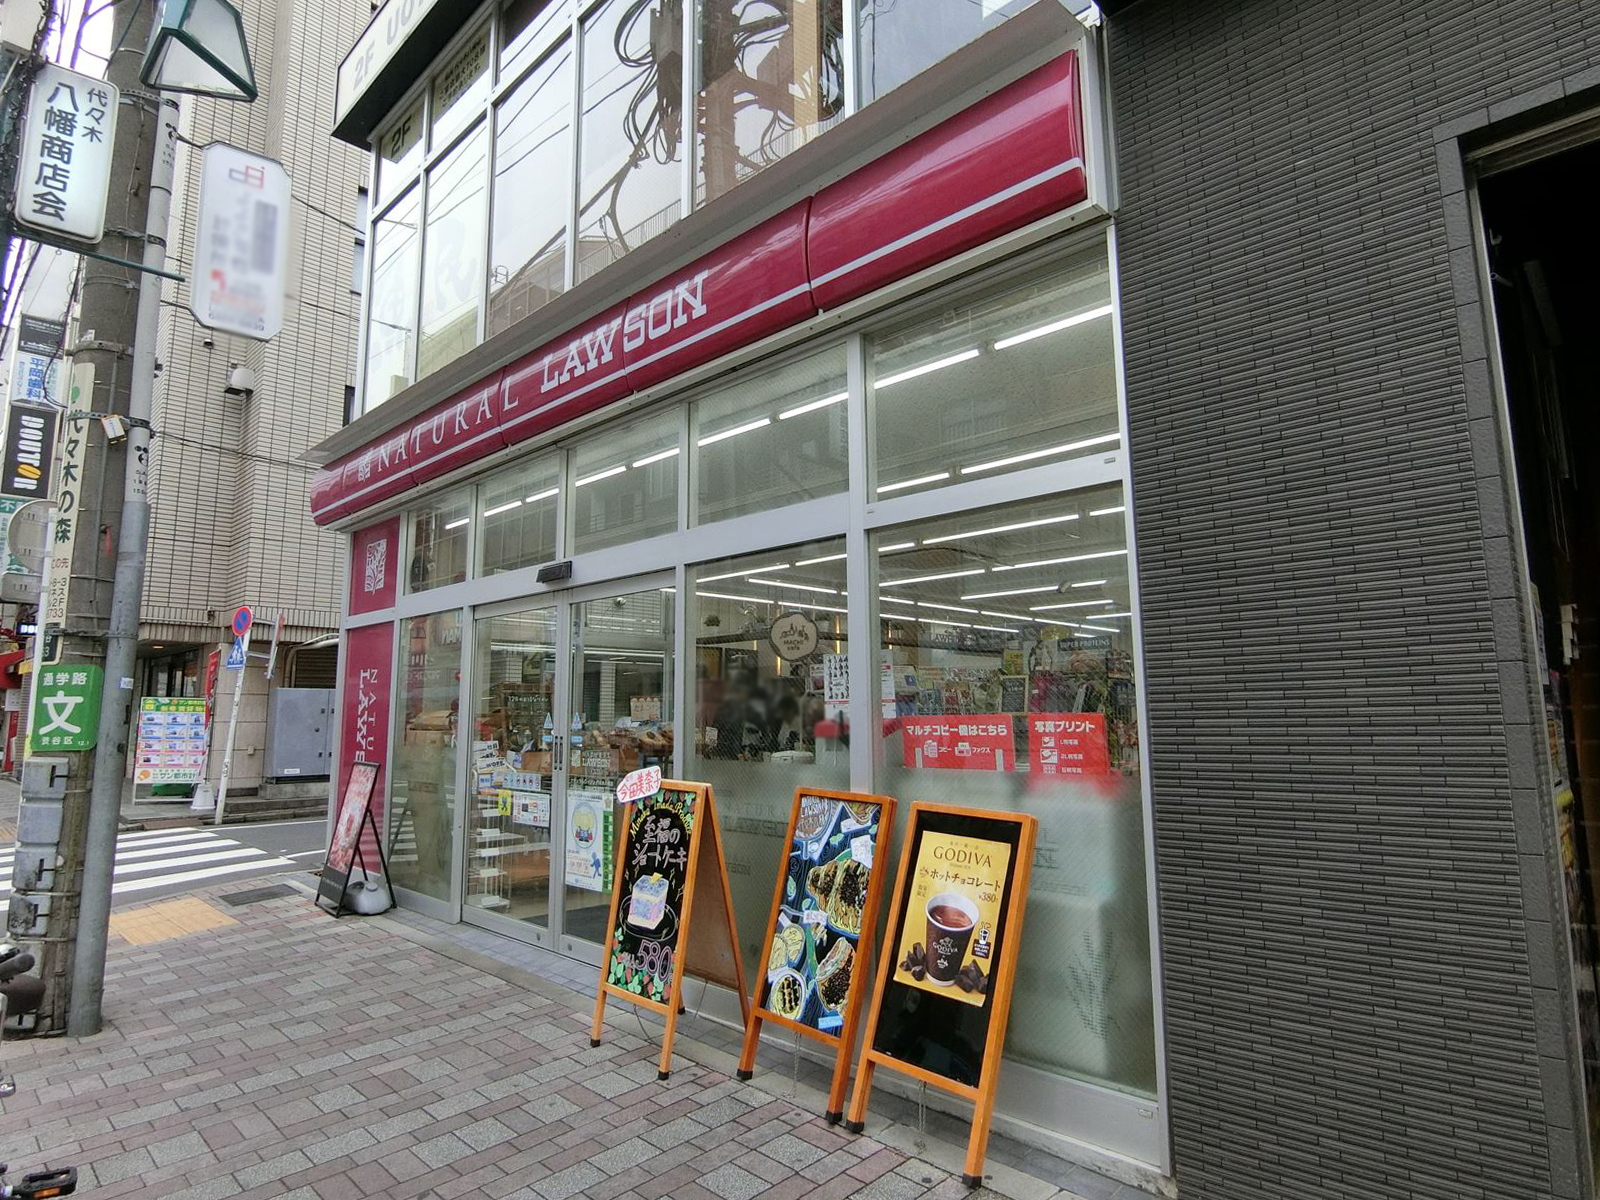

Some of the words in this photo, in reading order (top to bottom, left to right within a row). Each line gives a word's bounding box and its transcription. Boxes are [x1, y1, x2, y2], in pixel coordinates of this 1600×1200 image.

[353, 40, 375, 92] 2F
[81, 87, 108, 143] 代々木
[32, 81, 80, 221] 八幡商店会
[391, 114, 413, 159] 2F
[377, 375, 519, 473] NATURAL
[540, 274, 708, 394] LAWSON
[43, 672, 87, 686] 通学路
[38, 690, 84, 735] 文
[1034, 720, 1095, 732] 写真プリント
[41, 736, 73, 746] 渋谷区
[906, 724, 1007, 736] マルチコピー機はこちら
[618, 769, 660, 801] 今田美奈子
[643, 815, 681, 844] 至福の
[933, 845, 992, 868] GODIVA
[930, 869, 1000, 892] ホットチョコレート
[635, 939, 673, 983] 580
